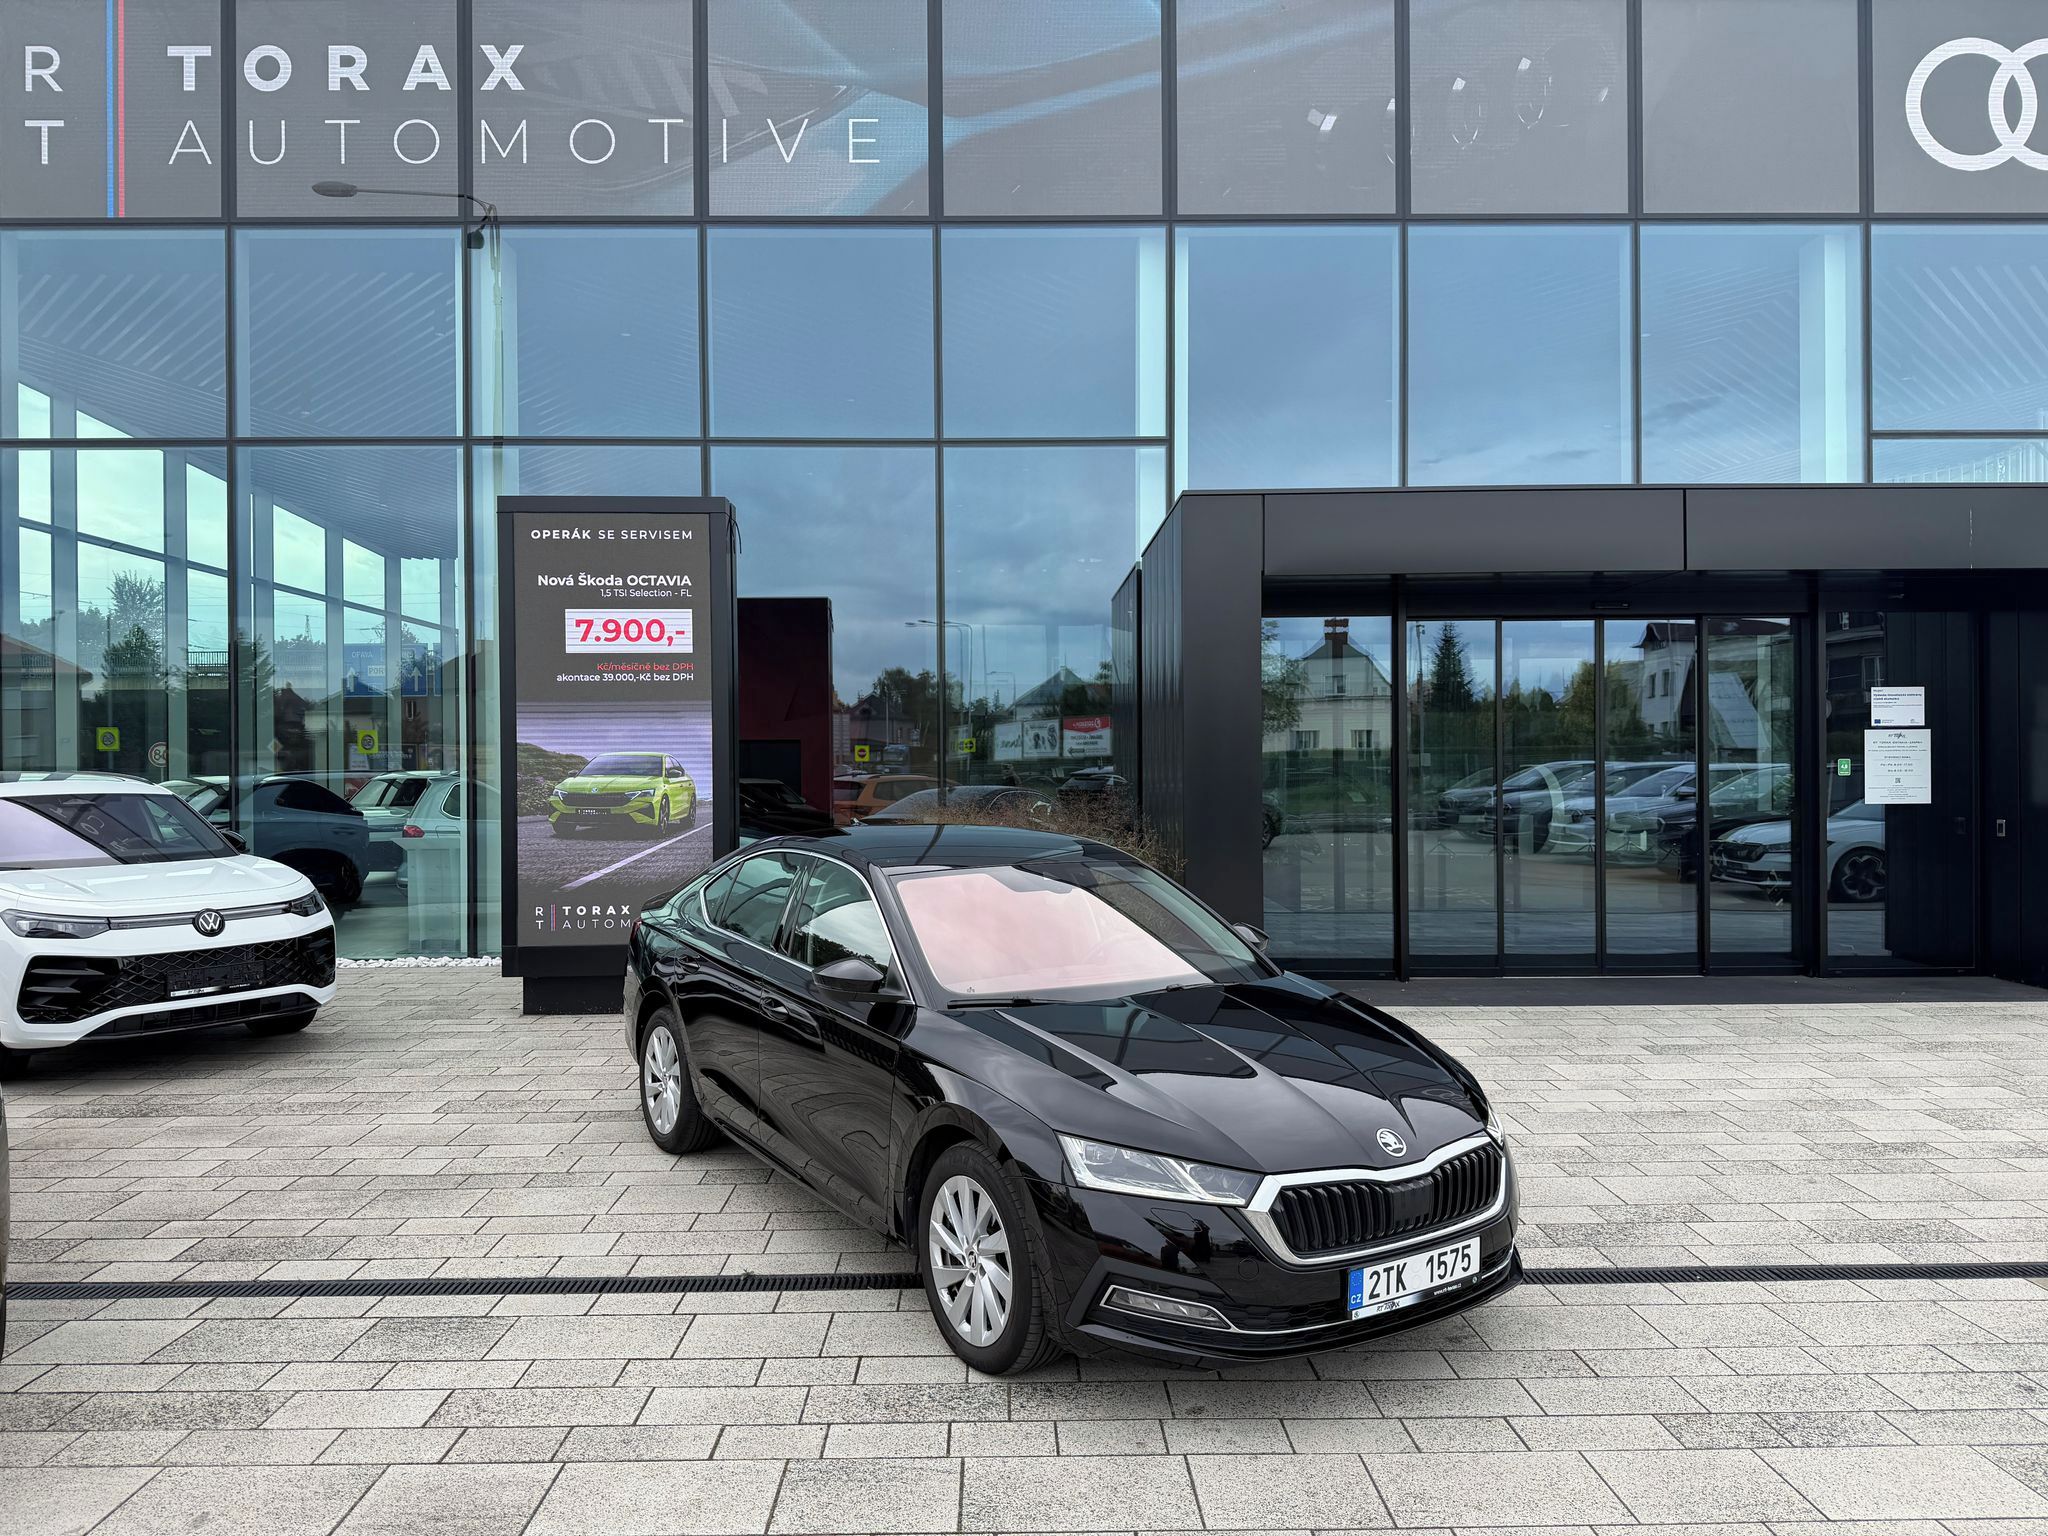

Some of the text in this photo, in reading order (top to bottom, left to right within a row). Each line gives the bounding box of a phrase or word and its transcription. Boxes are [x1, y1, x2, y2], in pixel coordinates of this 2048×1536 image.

[24, 44, 526, 93] R TORAX
[24, 118, 881, 166] T AUTOMOTIVE
[530, 527, 693, 540] OPERÁK SE SERVISEM
[537, 572, 692, 586] Nová Škoda OCTAVIA
[600, 589, 612, 598] 1,5
[613, 588, 628, 597] TSI
[629, 588, 673, 597] Selection
[680, 588, 692, 597] FL
[575, 618, 685, 647] 7.900,-
[653, 662, 670, 671] bez
[672, 662, 694, 671] DPH
[556, 672, 694, 683] akontace 39.000,-Kč bez DPH
[535, 905, 631, 917] R TORAX
[535, 919, 632, 930] T AUTOM
[1368, 1243, 1472, 1301] 2TK 1575
[1350, 1293, 1362, 1304] CZ
